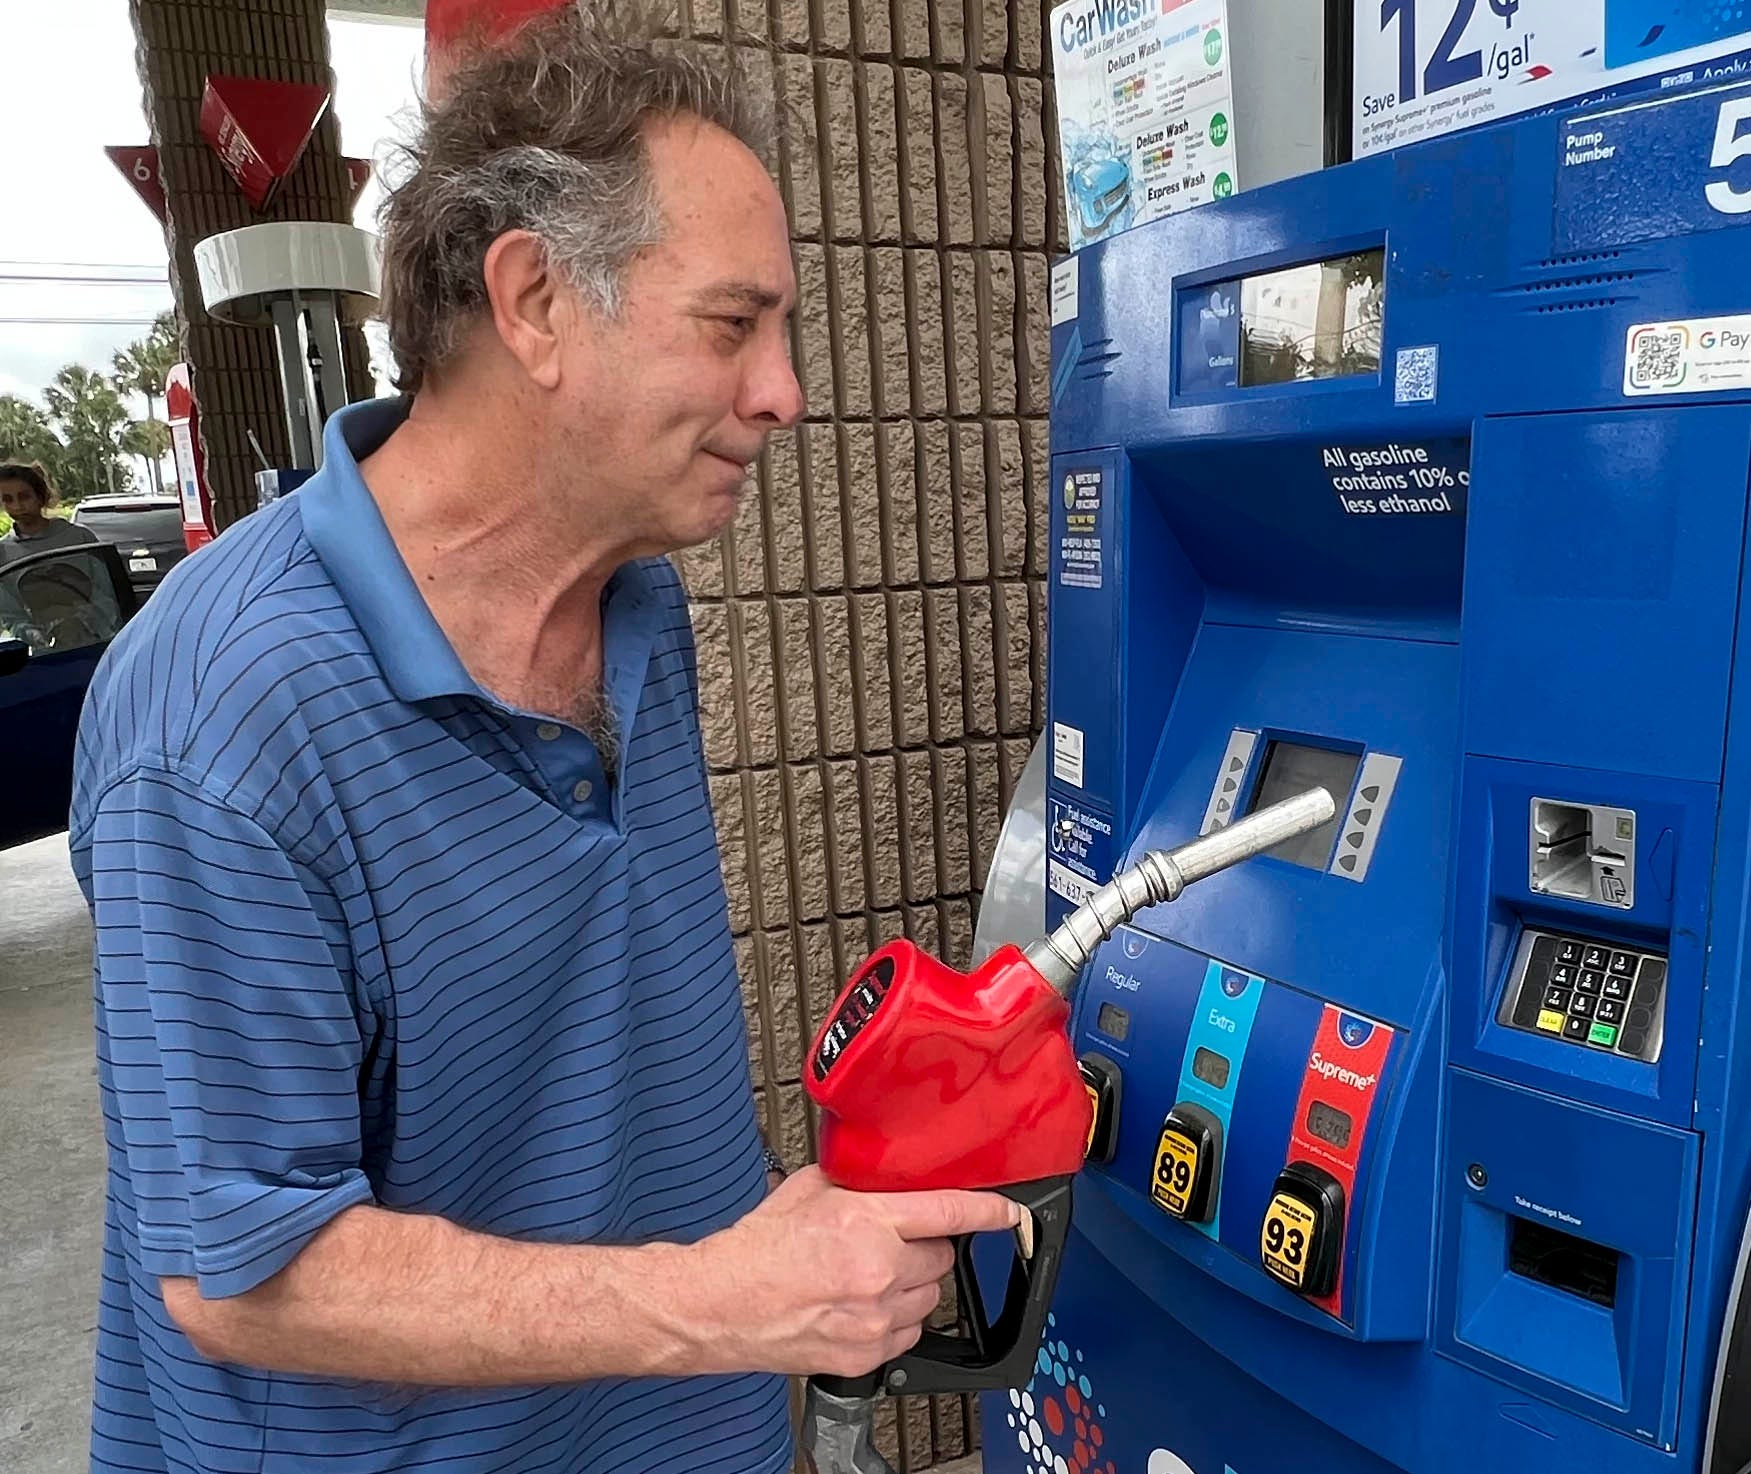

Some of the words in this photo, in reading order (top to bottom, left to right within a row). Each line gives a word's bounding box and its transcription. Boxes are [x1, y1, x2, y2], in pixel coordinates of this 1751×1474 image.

[1107, 52, 1136, 74] Deluxe
[1138, 37, 1162, 61] Wash
[1362, 93, 1396, 118] Save
[1461, 86, 1493, 105] gasoline
[1136, 130, 1164, 150] Deluxe
[1166, 118, 1190, 139] Wash
[1566, 131, 1604, 150] Pump
[1565, 145, 1616, 167] Number
[133, 157, 151, 182] 6
[1147, 182, 1181, 202] Express
[1182, 171, 1206, 191] Wash
[1700, 331, 1716, 349] G
[1720, 330, 1751, 351] Pay
[1322, 447, 1347, 467] All
[1349, 444, 1429, 472] gasoline
[1332, 470, 1409, 491] contains
[1408, 467, 1454, 489] 10%
[1339, 494, 1377, 514] less
[1378, 491, 1452, 514] ethanol
[1105, 965, 1142, 992] Regular
[1208, 1007, 1236, 1033] Extra
[1571, 1020, 1580, 1030] 0
[1309, 1052, 1377, 1091] Supreme+
[1157, 1151, 1191, 1194] 89
[1514, 1195, 1531, 1209] Take
[1531, 1203, 1558, 1219] receipt
[1558, 1210, 1582, 1226] below
[1265, 1217, 1305, 1266] 93
